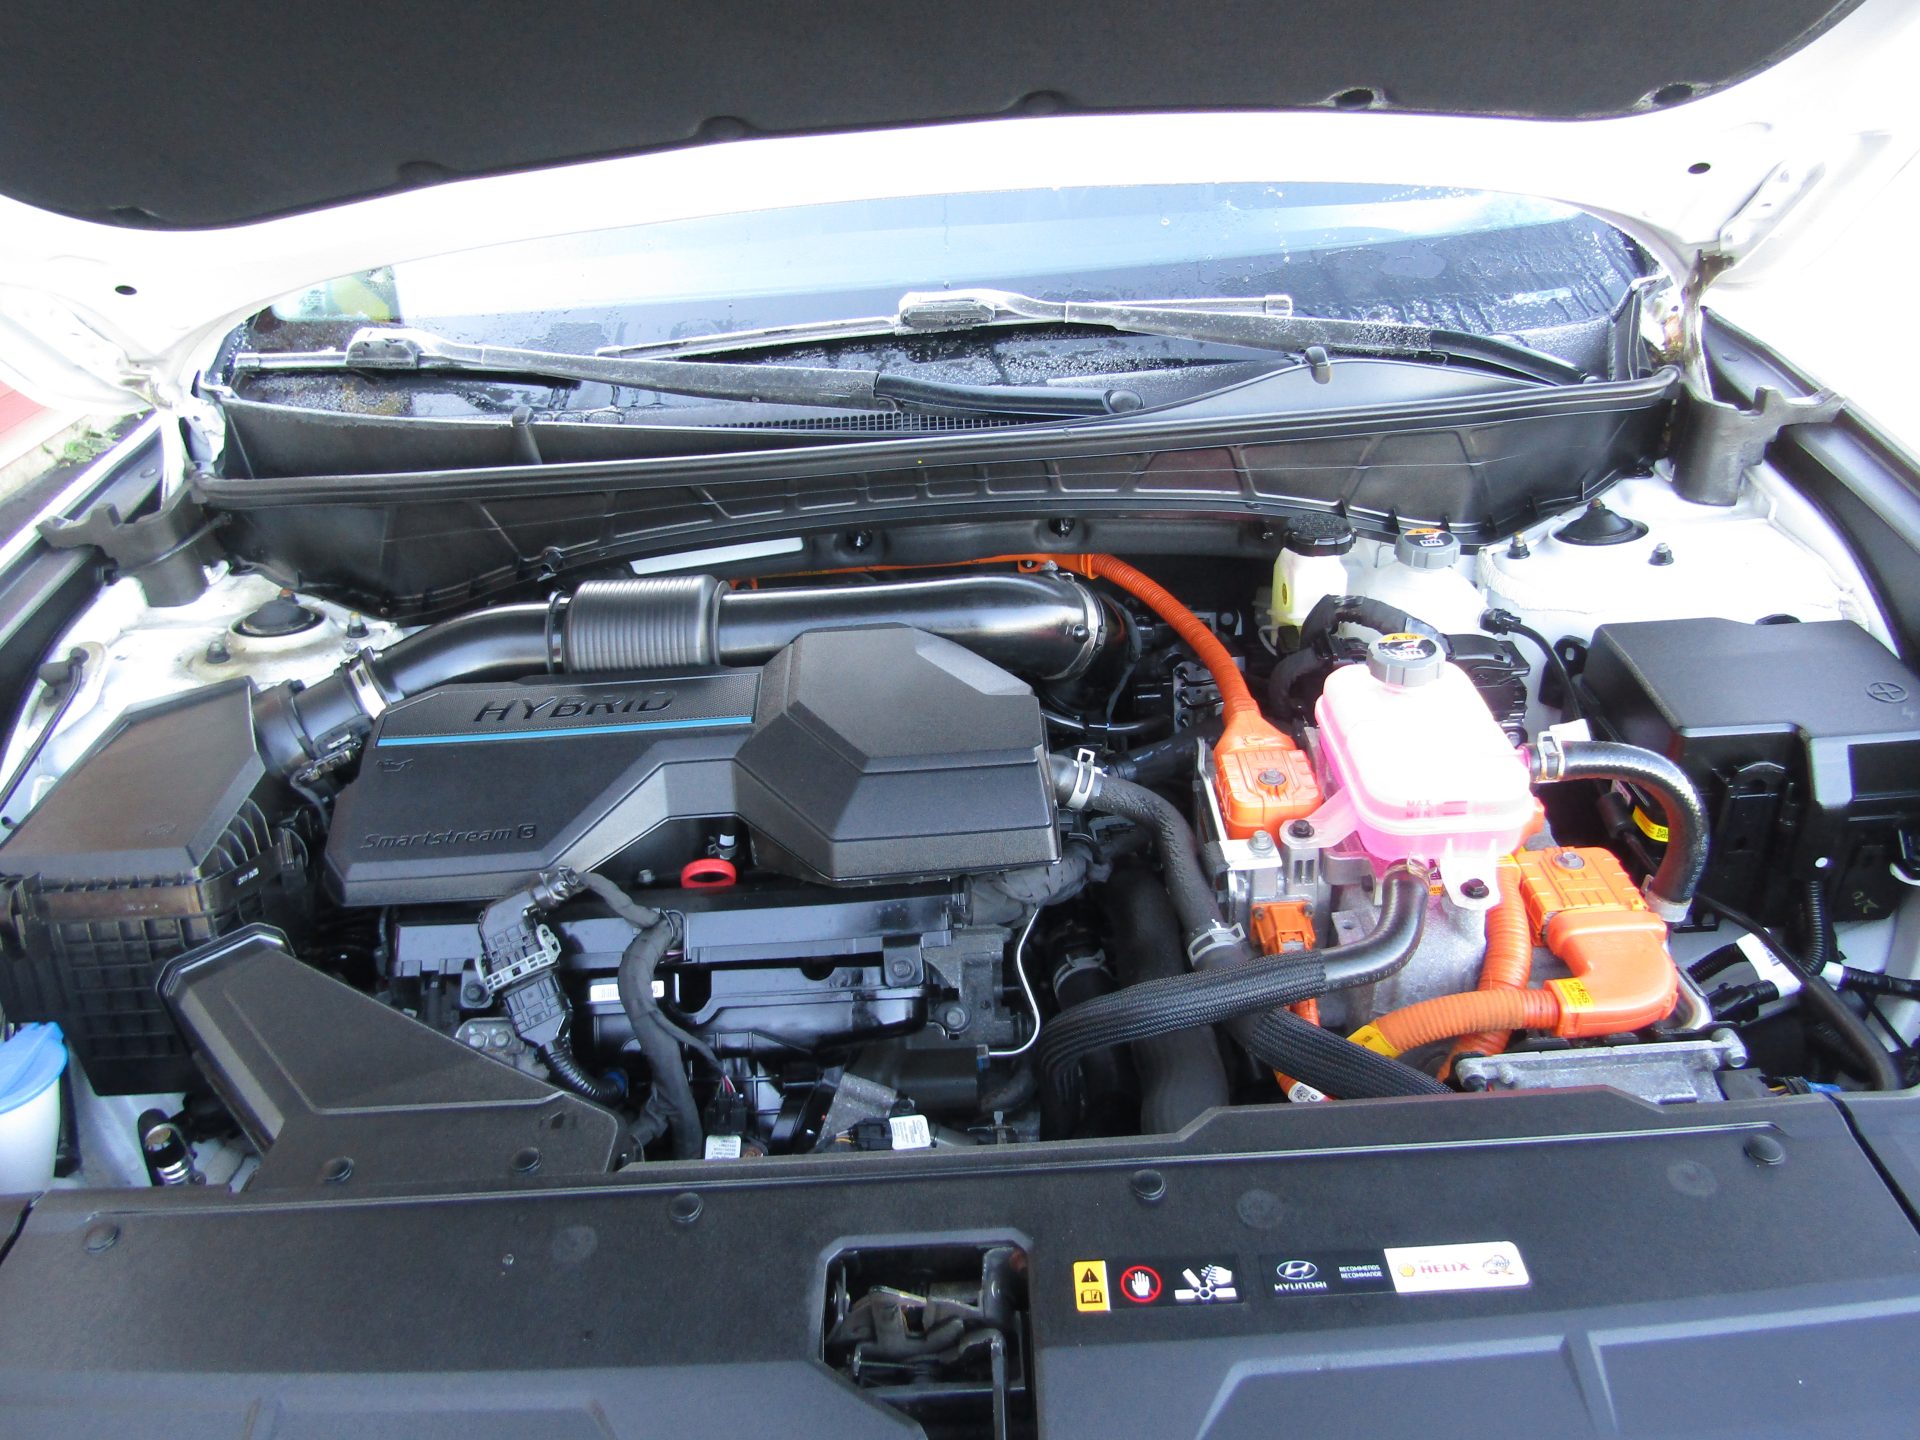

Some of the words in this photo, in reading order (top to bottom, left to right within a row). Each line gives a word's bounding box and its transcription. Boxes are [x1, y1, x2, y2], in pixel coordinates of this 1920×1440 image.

[474, 689, 676, 722] HYBRID
[360, 828, 512, 848] Smartstream
[1338, 1264, 1381, 1272] RECOMMENDS
[1420, 1263, 1470, 1274] HELIX
[1340, 1271, 1383, 1279] RECOMMANDE
[1274, 1281, 1328, 1291] HYUNDAI
